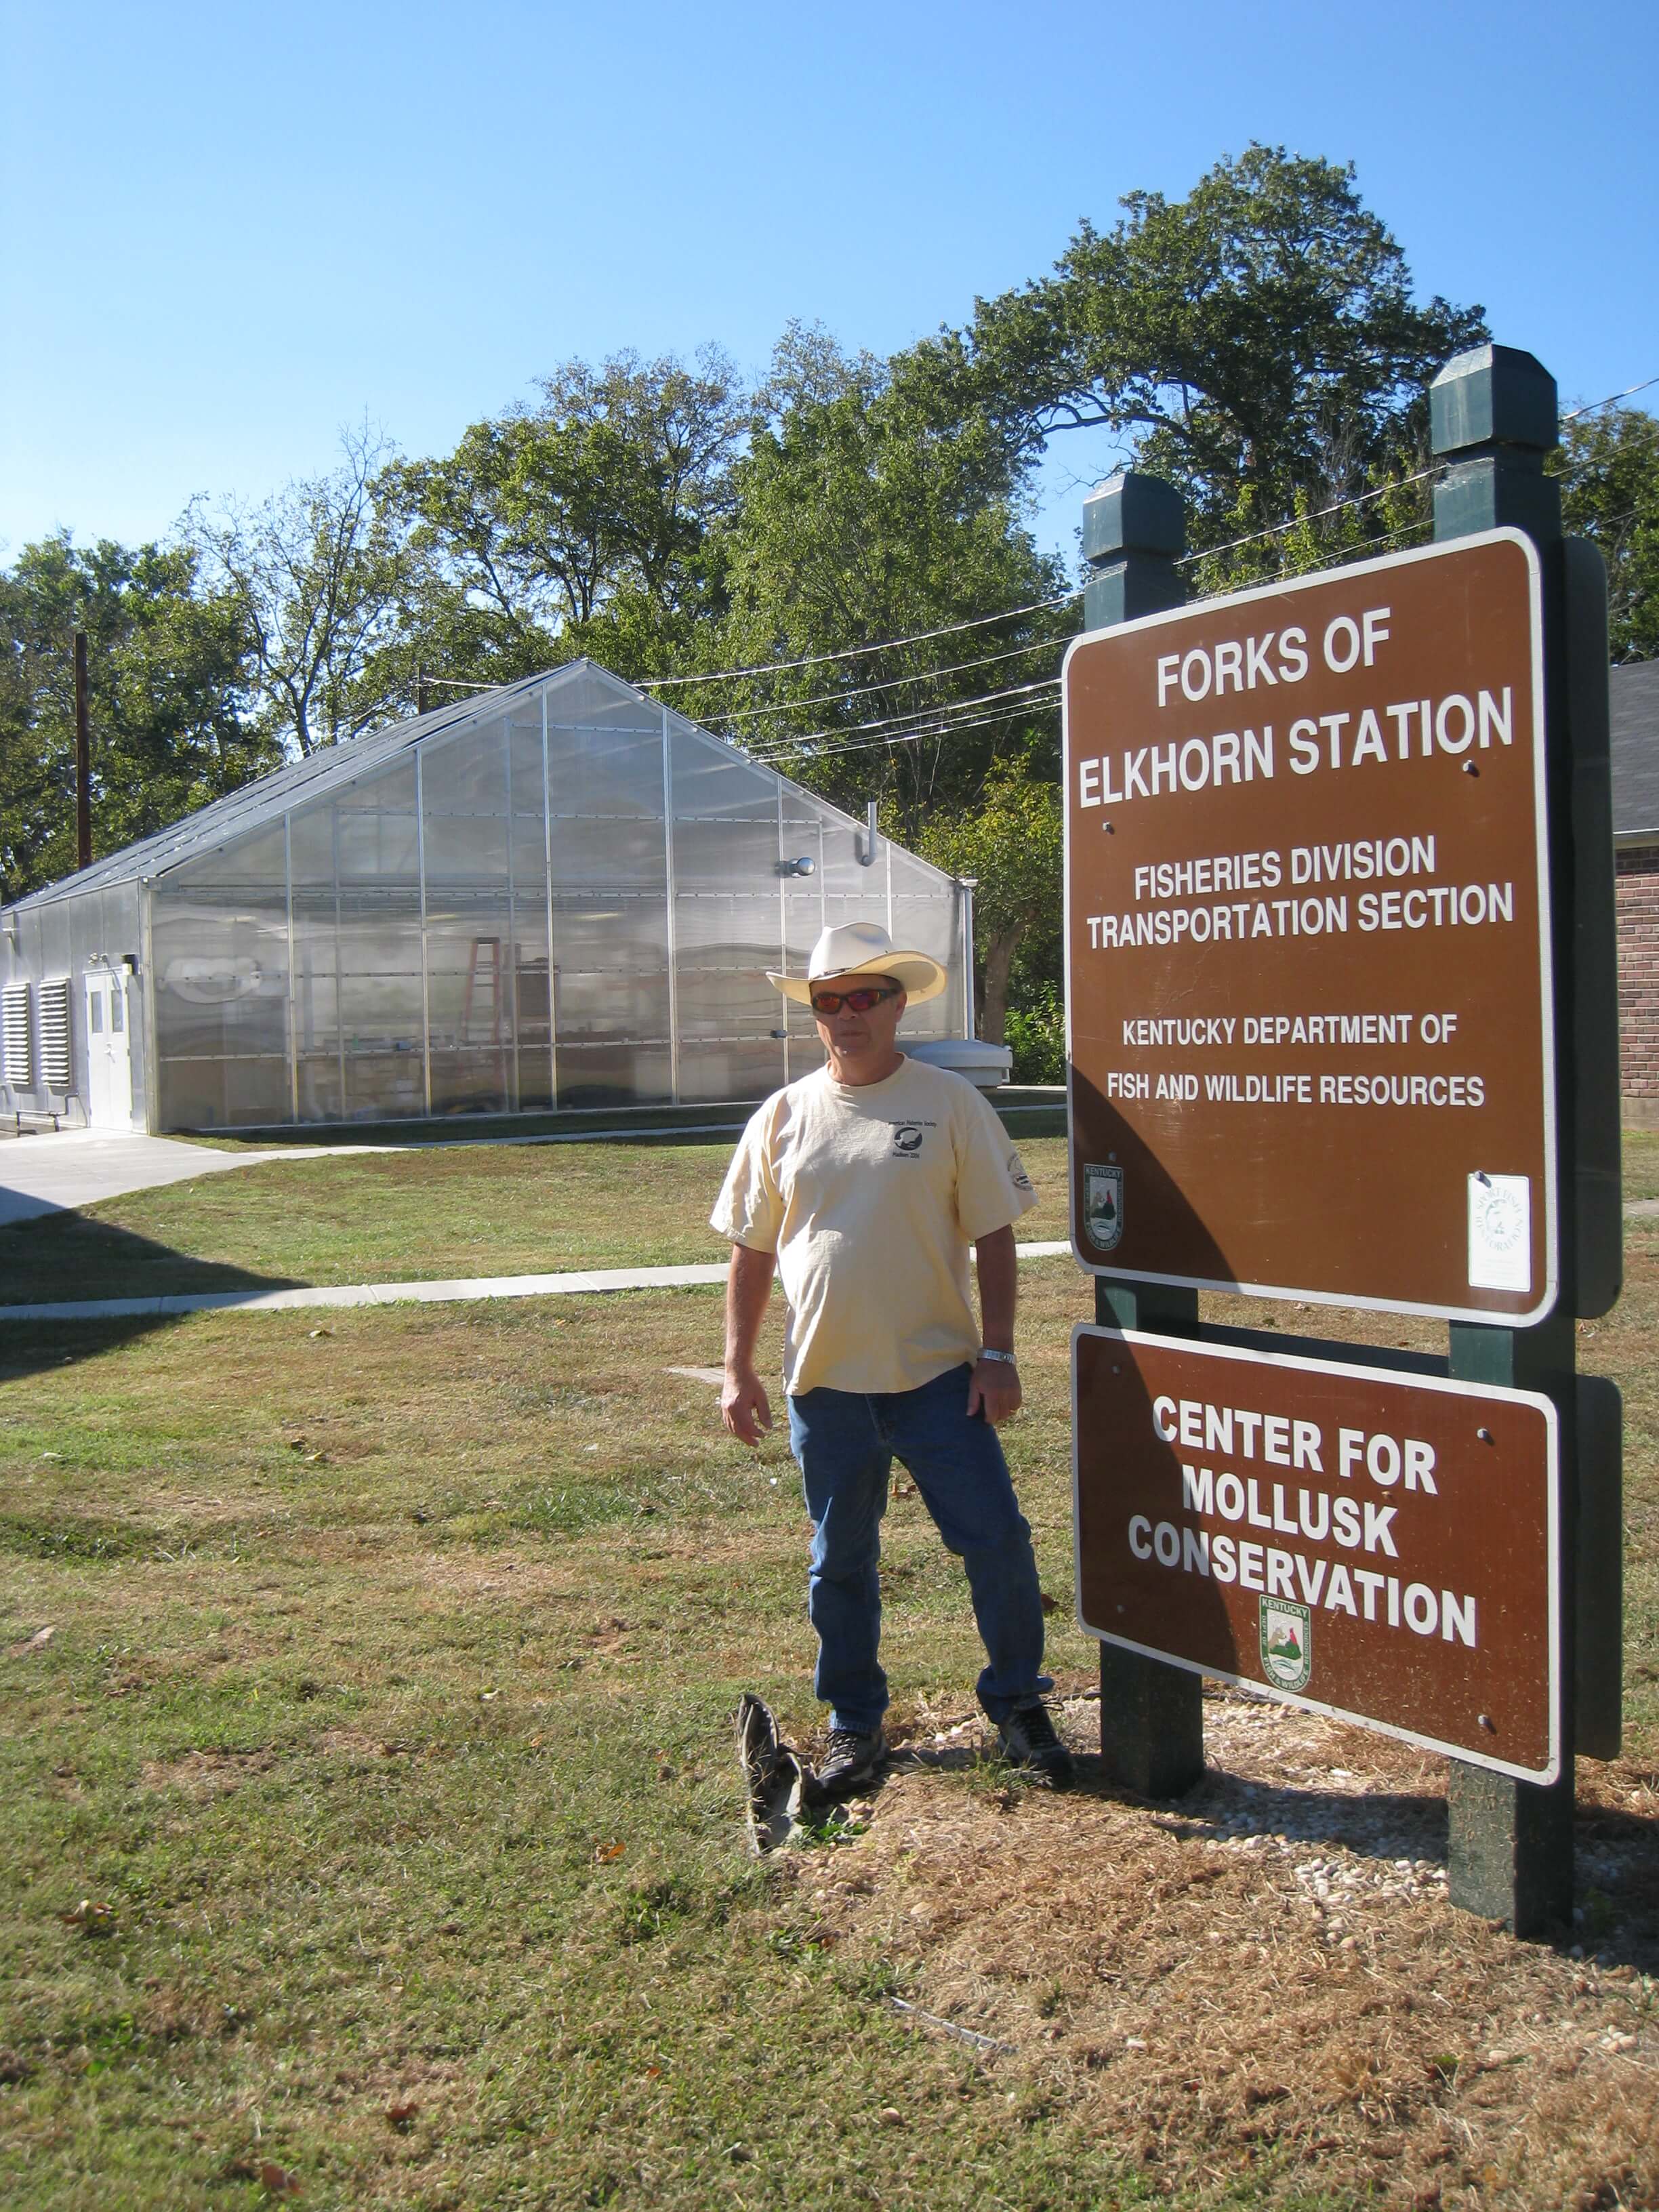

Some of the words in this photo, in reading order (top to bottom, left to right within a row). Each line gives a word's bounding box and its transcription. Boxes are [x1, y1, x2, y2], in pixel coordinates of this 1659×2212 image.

[1158, 627, 1309, 707] FORKS
[1323, 607, 1391, 674] OF
[1080, 726, 1274, 808] ELKHORN
[1289, 687, 1513, 775] STATION
[1134, 851, 1281, 900] FISHERIES
[1291, 835, 1435, 884] DIVISION
[1087, 896, 1347, 949] TRANSPORTATION
[1358, 882, 1513, 930] SECTION
[1123, 1017, 1237, 1046] KENTUCKY
[1244, 1015, 1412, 1044] DEPARTMENT
[1420, 1013, 1457, 1044] OF
[1107, 1072, 1149, 1100] FISH
[1155, 1073, 1198, 1101] AND
[1204, 1074, 1312, 1103] WILDLIFE
[1319, 1076, 1485, 1107] RESOURCES
[1085, 1167, 1121, 1179] KENTUCKY
[1153, 1395, 1324, 1473] CENTER
[1338, 1427, 1438, 1495] FOR
[1183, 1464, 1399, 1557] MOLLUSK
[1128, 1515, 1477, 1648] CONSERVATION
[1262, 1597, 1308, 1617] KENTUCKY
[1280, 1669, 1309, 1689] WILDLIFE
